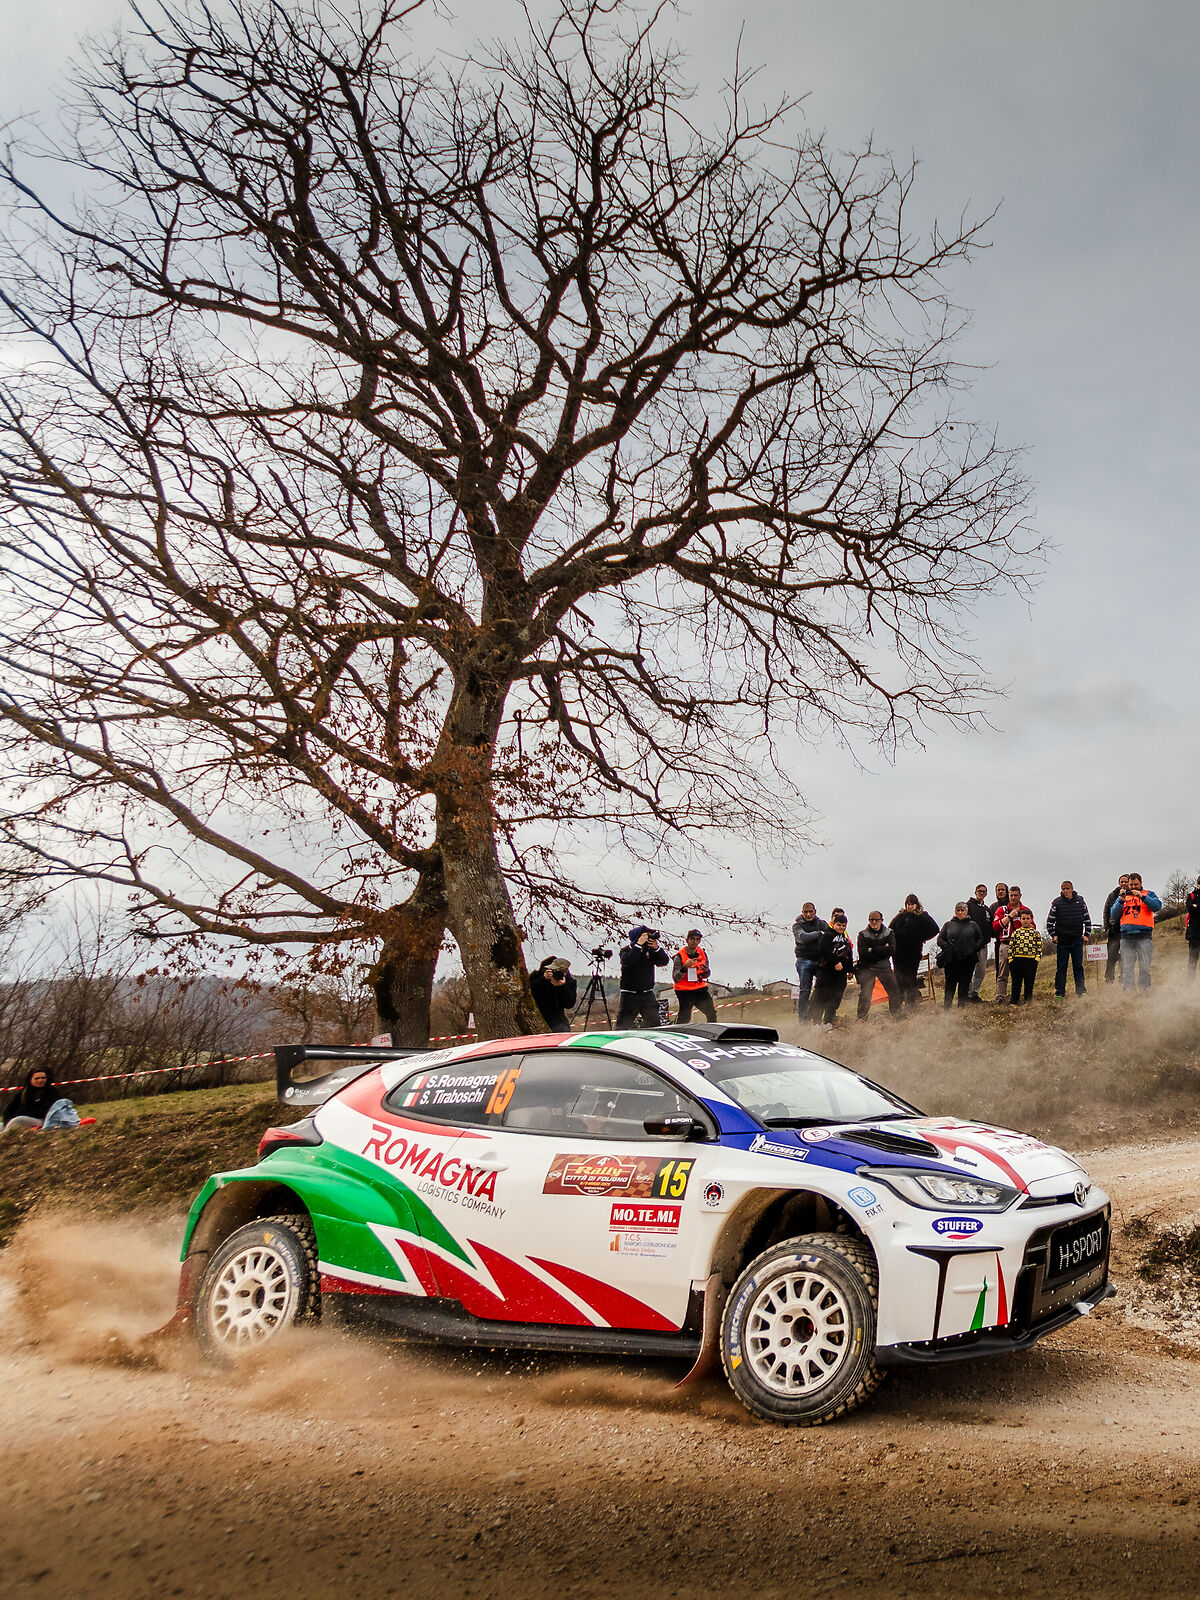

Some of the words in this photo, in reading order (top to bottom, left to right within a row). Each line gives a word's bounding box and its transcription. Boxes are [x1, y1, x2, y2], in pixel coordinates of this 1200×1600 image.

[426, 1074, 498, 1090] S.Romagna
[419, 1091, 430, 1105] S.
[432, 1088, 486, 1105] Tiraboschi
[485, 1069, 522, 1114] 15
[761, 1143, 806, 1157] MICHELIN
[361, 1123, 498, 1202] ROMAGNA
[575, 1166, 622, 1176] Rally
[659, 1161, 692, 1197] 15
[417, 1180, 459, 1204] LOGISTICS
[461, 1196, 506, 1219] COMPANY
[612, 1208, 677, 1224] MO.TE.MI.
[865, 1207, 878, 1218] FIX
[876, 1204, 884, 1212] IT
[937, 1221, 978, 1231] STUFFER
[1059, 1227, 1102, 1269] H-SPORT
[730, 1282, 754, 1344] MICHELIN
